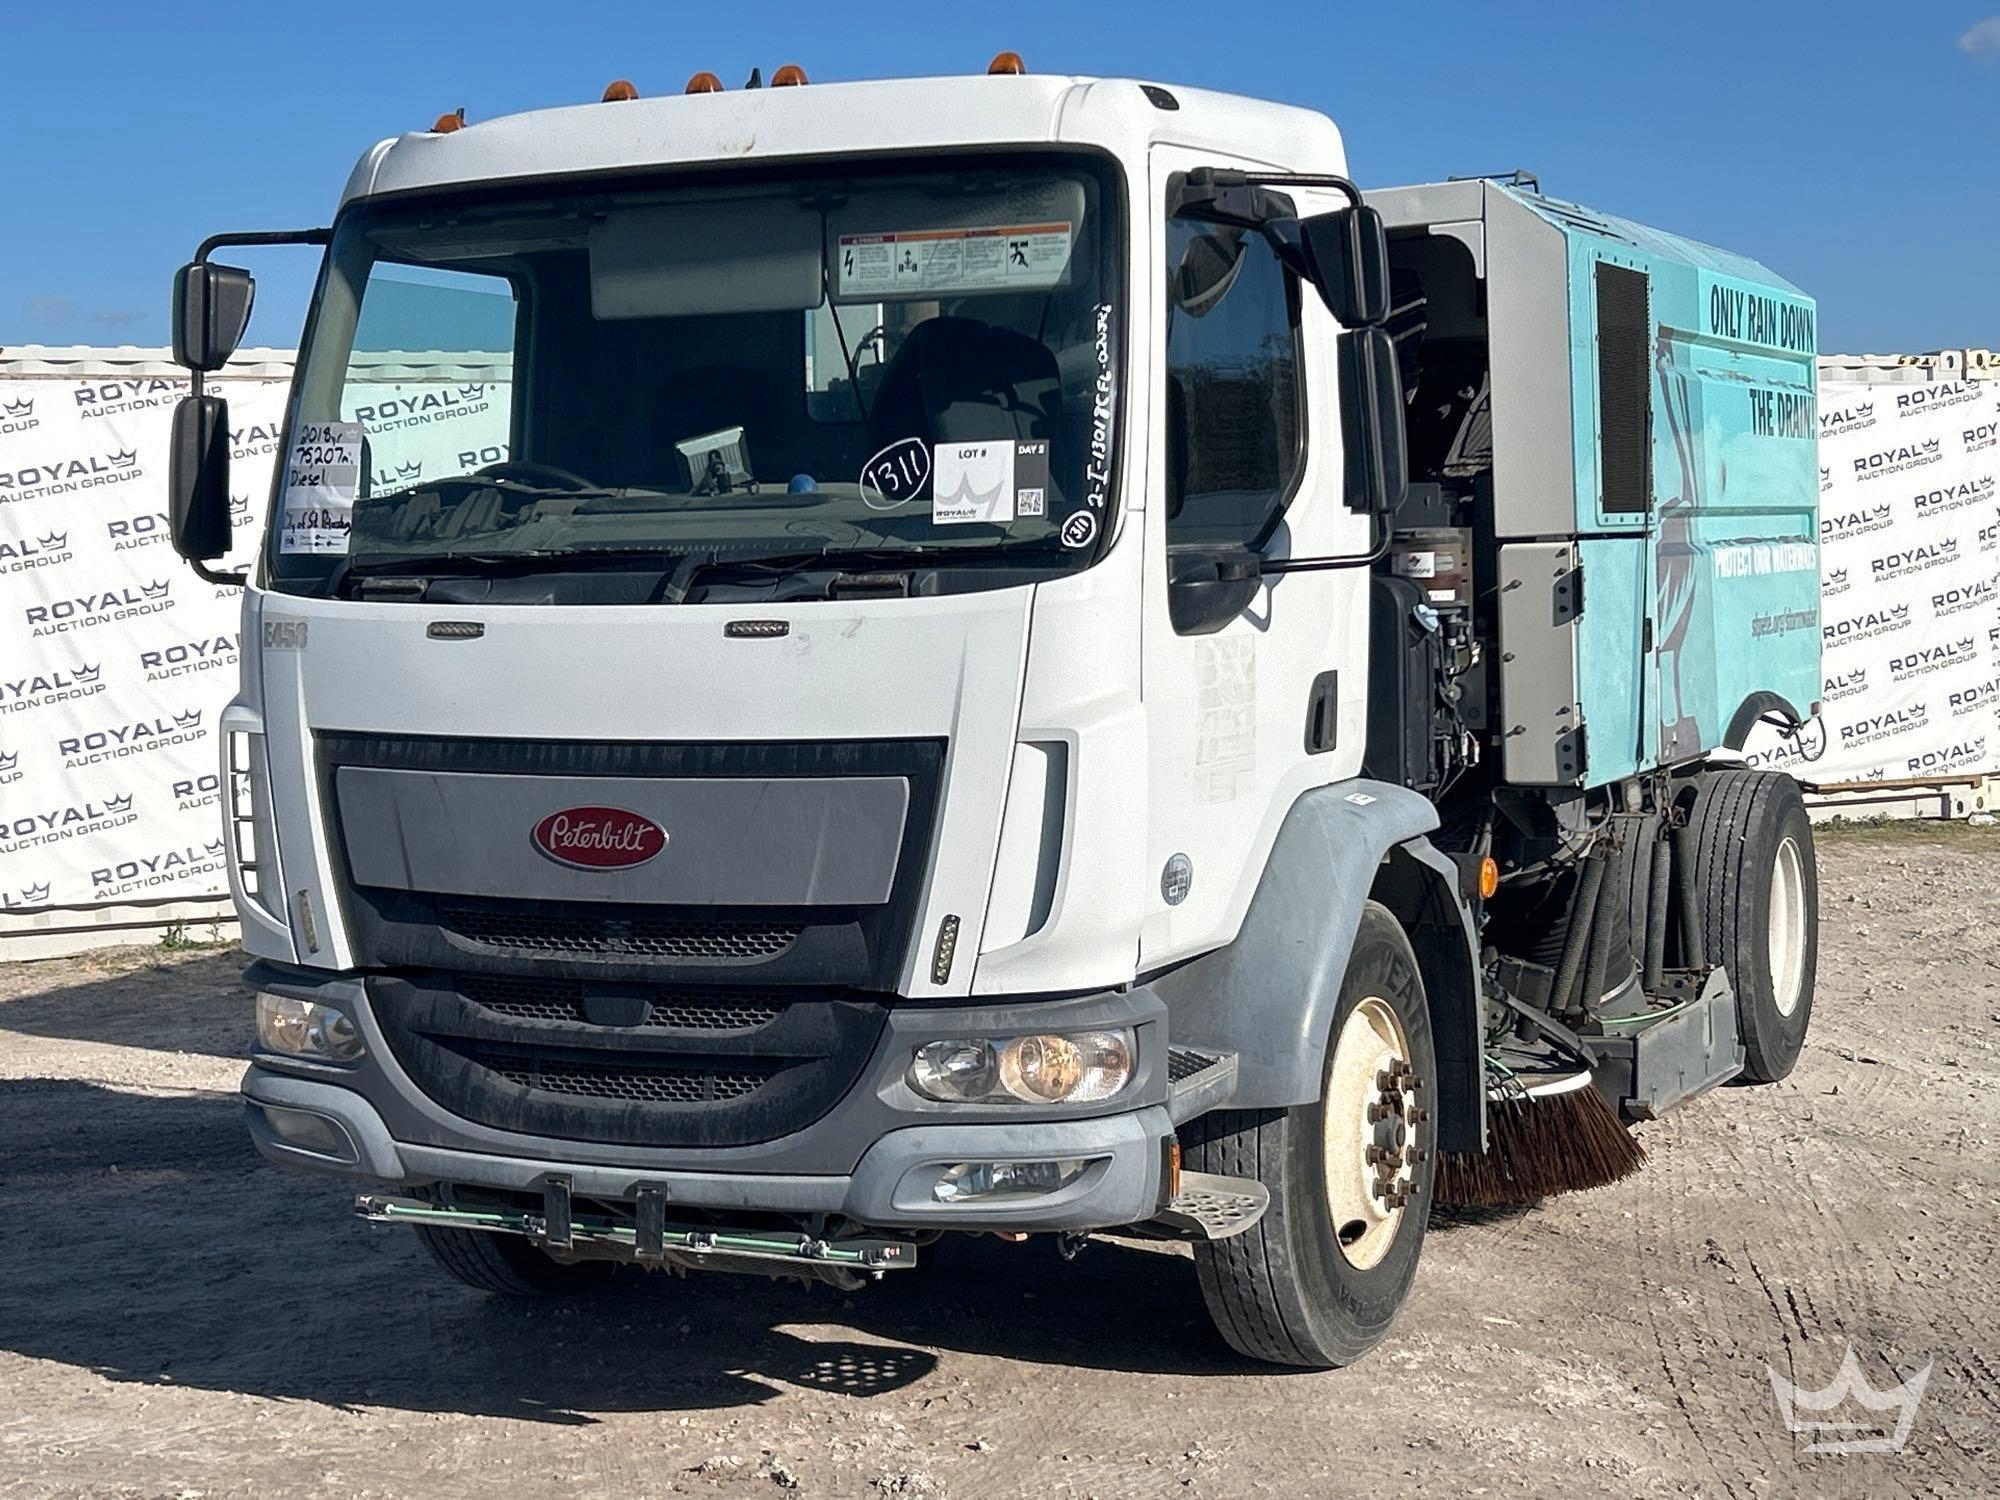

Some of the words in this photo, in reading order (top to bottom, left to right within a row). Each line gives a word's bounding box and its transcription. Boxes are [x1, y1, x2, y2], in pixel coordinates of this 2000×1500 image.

[1710, 284, 1744, 338] ONLY
[1748, 294, 1776, 346] RAIN
[1780, 302, 1813, 353] DOWN
[81, 399, 159, 420] AUCTION
[355, 390, 460, 423] ROYAL
[1897, 382, 1965, 409] ROYAL
[1900, 401, 1946, 419] AUCTION
[1948, 390, 1983, 406] GROUP
[363, 413, 431, 435] AUCTION
[434, 402, 489, 421] GROUP
[1749, 388, 1774, 435] THE
[1819, 408, 1857, 428] YAL
[1839, 418, 1877, 434] GROUP
[0, 418, 40, 435] OUP
[228, 423, 281, 446] YAL
[1963, 422, 1998, 444] ROY
[958, 449, 978, 460] LOT
[1018, 445, 1037, 455] DAY
[1854, 445, 1923, 472] ROYAL
[0, 457, 109, 489] ROYAL
[290, 468, 326, 488] Diesel
[868, 449, 922, 496] 1311
[1857, 464, 1904, 482] AUCTION
[1905, 453, 1943, 470] GROUP
[0, 481, 78, 504] AUCTION
[81, 469, 143, 489] GROUP
[1914, 481, 1981, 508] ROYAL
[1821, 510, 1874, 534] OYAL
[1917, 500, 1963, 519] AUCTION
[1821, 526, 1854, 545] CTION
[1855, 519, 1894, 535] GROUP
[11, 552, 73, 572] GROUP
[1712, 545, 1752, 578] PROTECT
[1871, 545, 1940, 573] ROYAL
[1874, 564, 1922, 583] AUCTION
[1924, 553, 1961, 569] GROUP
[1822, 583, 1851, 598] ROUP
[26, 588, 142, 625] ROYAL
[32, 613, 110, 638] AUCTION
[114, 600, 175, 620] GROUP
[1823, 611, 1891, 639] ROYAL
[1825, 631, 1873, 649] AUCTION
[1874, 619, 1911, 635] GROUP
[146, 657, 223, 682] AUCTION
[1889, 643, 1957, 673] ROYAL
[1893, 664, 1940, 683] AUCTION
[1942, 652, 1978, 668] GROUP
[0, 672, 72, 701] YAL
[0, 699, 41, 715] TION
[44, 684, 106, 704] GROUP
[1832, 684, 1869, 700] GROUP
[58, 717, 173, 756] ROYAL
[1840, 710, 1909, 740] ROYAL
[1844, 731, 1890, 750] AUCTION
[1892, 718, 1929, 735] GROUP
[65, 744, 143, 769] AUCTION
[146, 729, 207, 751] GROUP
[1745, 744, 1800, 767] OYAL
[1908, 742, 1975, 771] ROYAL
[76, 813, 138, 836] GROUP
[550, 815, 654, 851] Peterbilt
[91, 847, 206, 887] ROYAL
[95, 872, 175, 899] AUCTION
[178, 859, 227, 880] GROU
